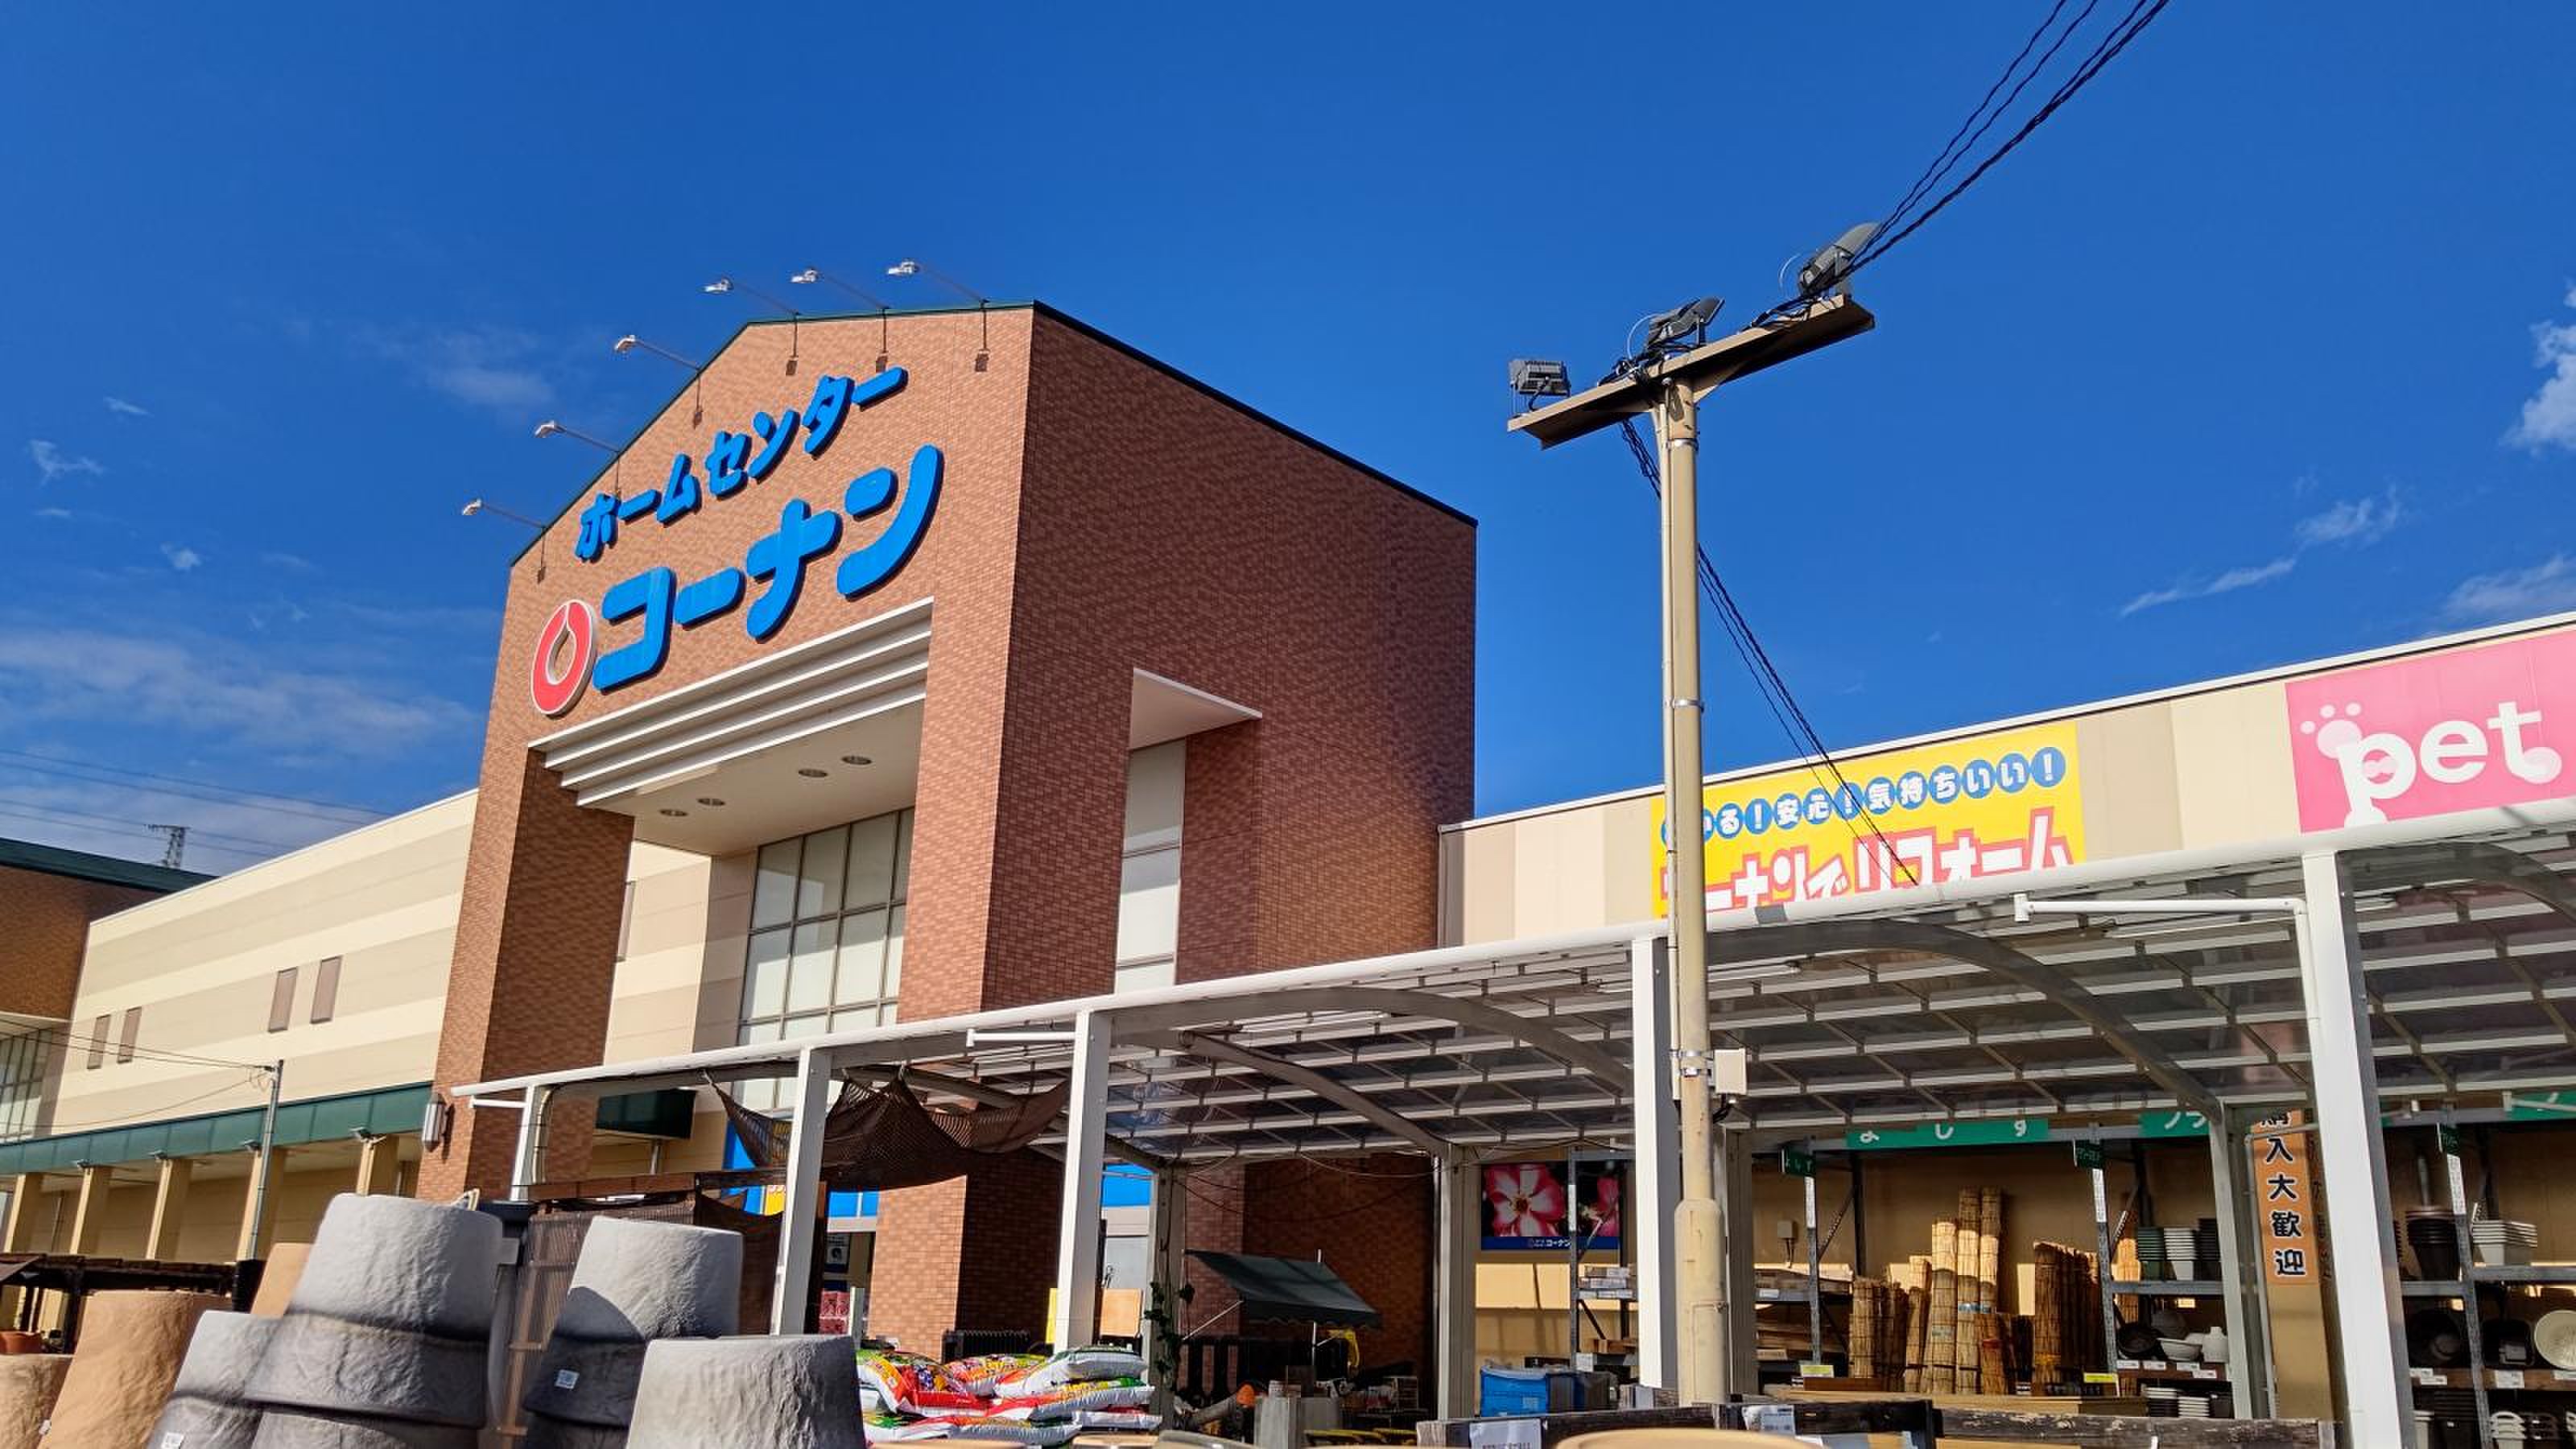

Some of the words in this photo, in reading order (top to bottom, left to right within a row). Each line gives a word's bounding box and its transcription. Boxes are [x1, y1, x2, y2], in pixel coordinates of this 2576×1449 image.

[575, 366, 908, 562] ホームセンター
[592, 444, 944, 695] コーナン
[2333, 700, 2563, 828] pet
